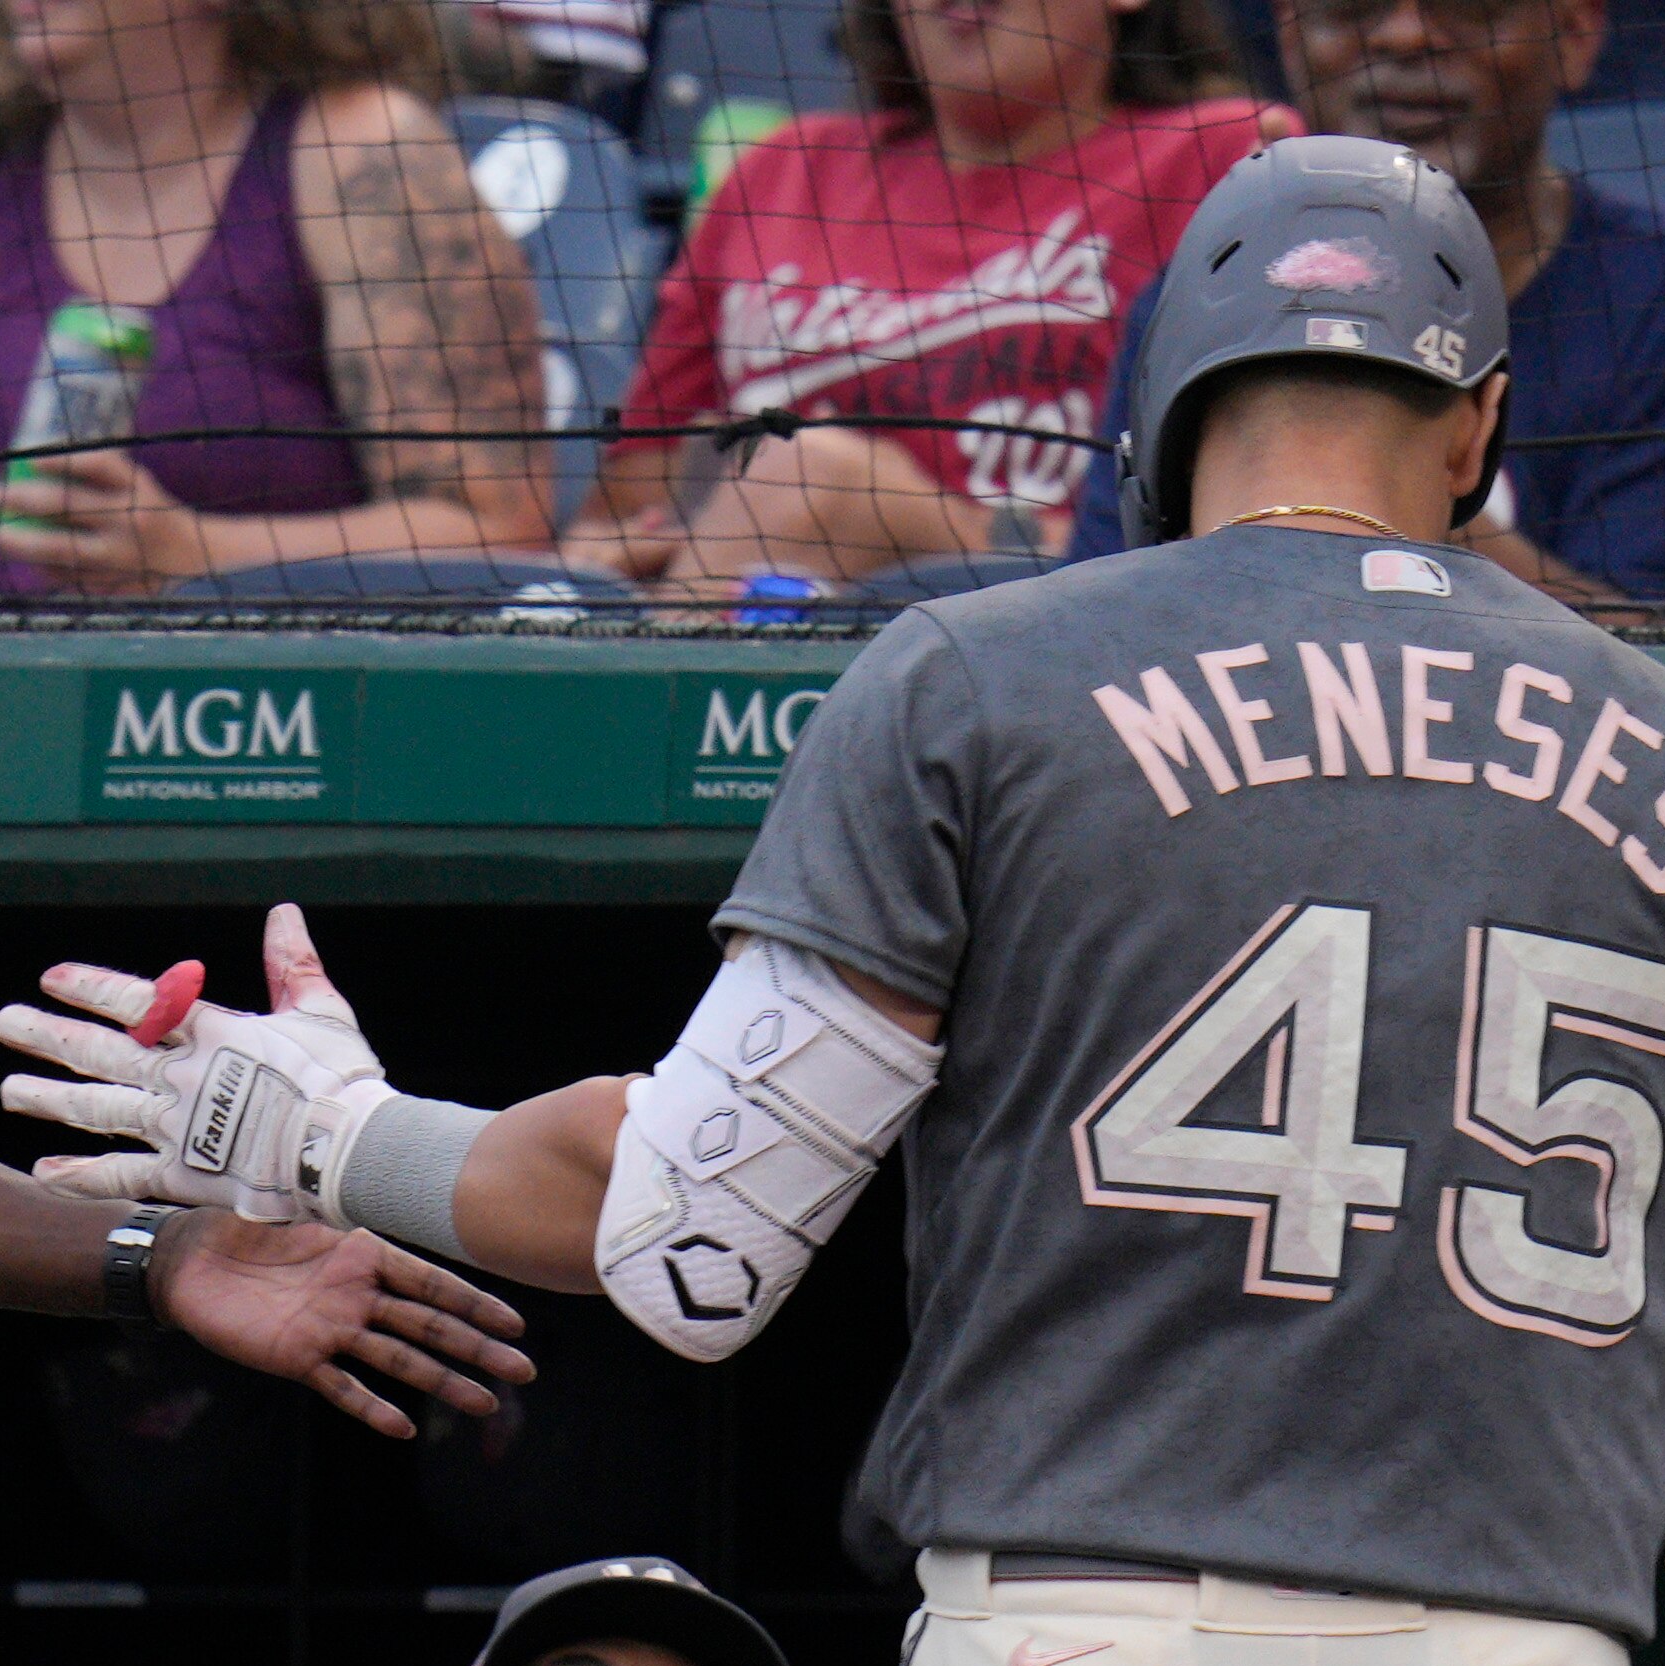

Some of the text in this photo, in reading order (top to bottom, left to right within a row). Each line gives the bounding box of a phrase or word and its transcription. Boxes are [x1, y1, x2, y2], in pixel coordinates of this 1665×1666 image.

[1413, 324, 1467, 382] 45
[108, 688, 322, 758] MGM
[191, 1060, 246, 1167] franklin
